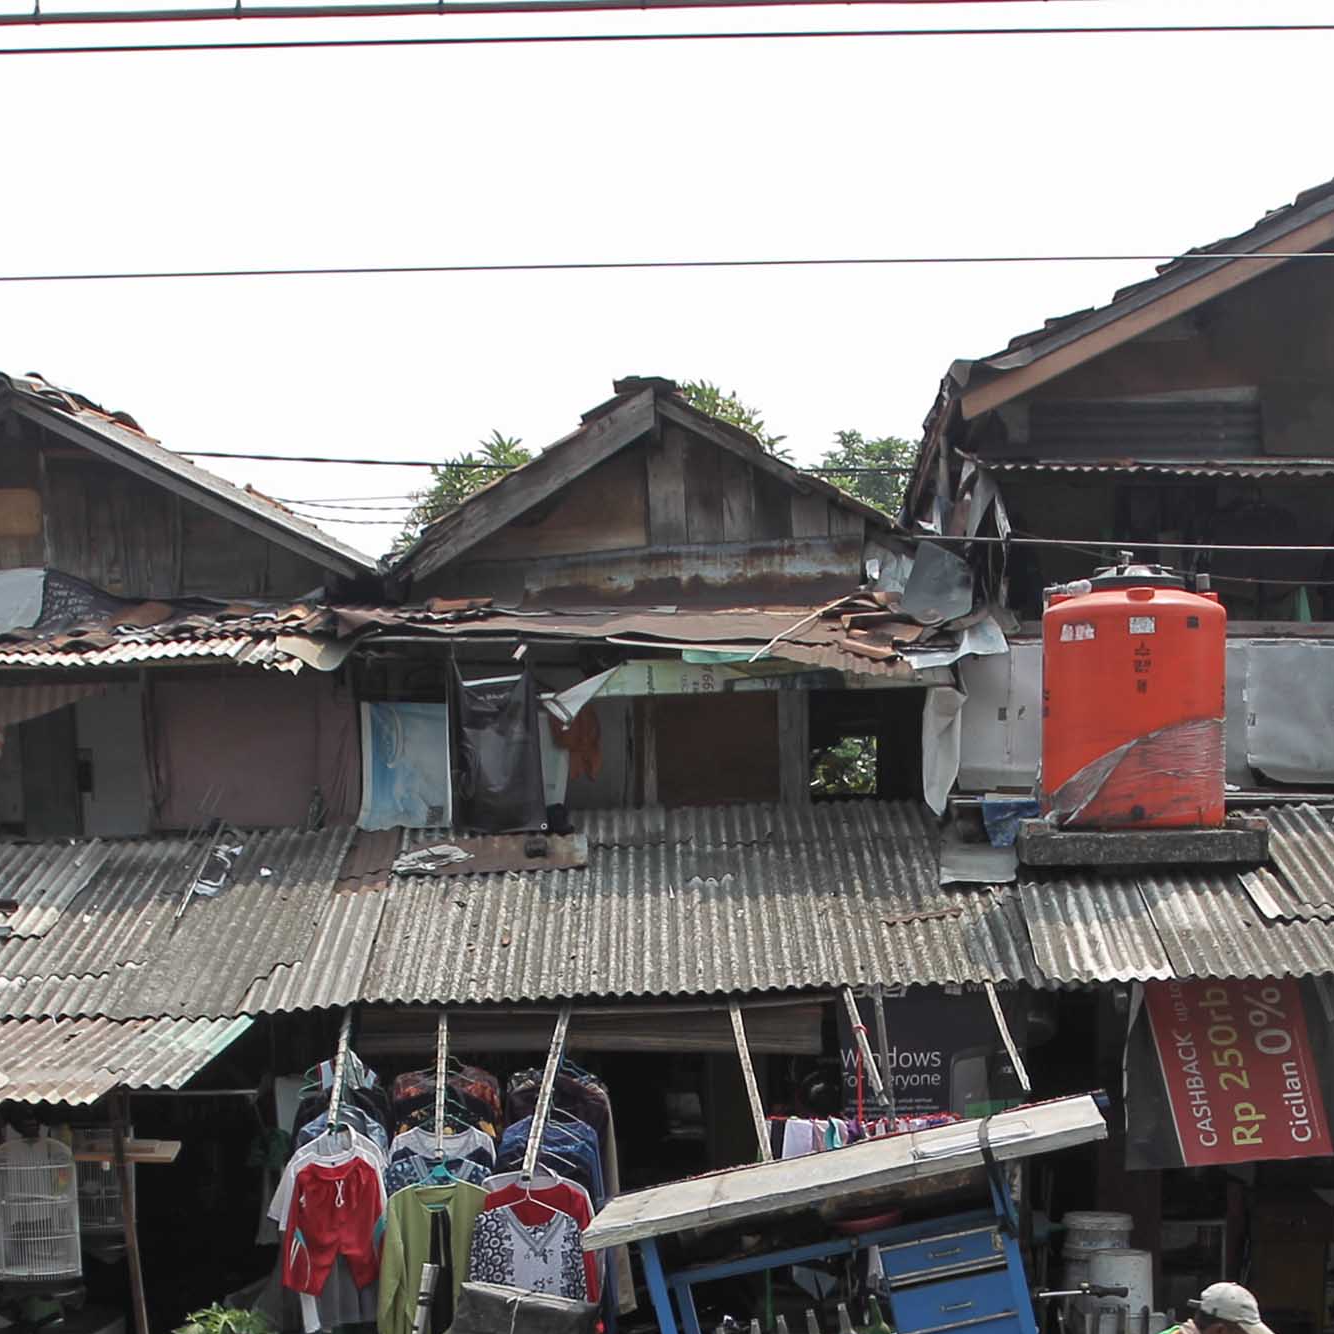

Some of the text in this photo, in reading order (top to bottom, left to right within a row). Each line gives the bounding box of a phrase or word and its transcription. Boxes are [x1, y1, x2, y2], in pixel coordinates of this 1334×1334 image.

[840, 1046, 942, 1069] Wndows
[1173, 1029, 1218, 1147] CASHBACK
[1199, 986, 1267, 1146] Rp 250rb
[1243, 986, 1313, 1142] Cicilan 0%
